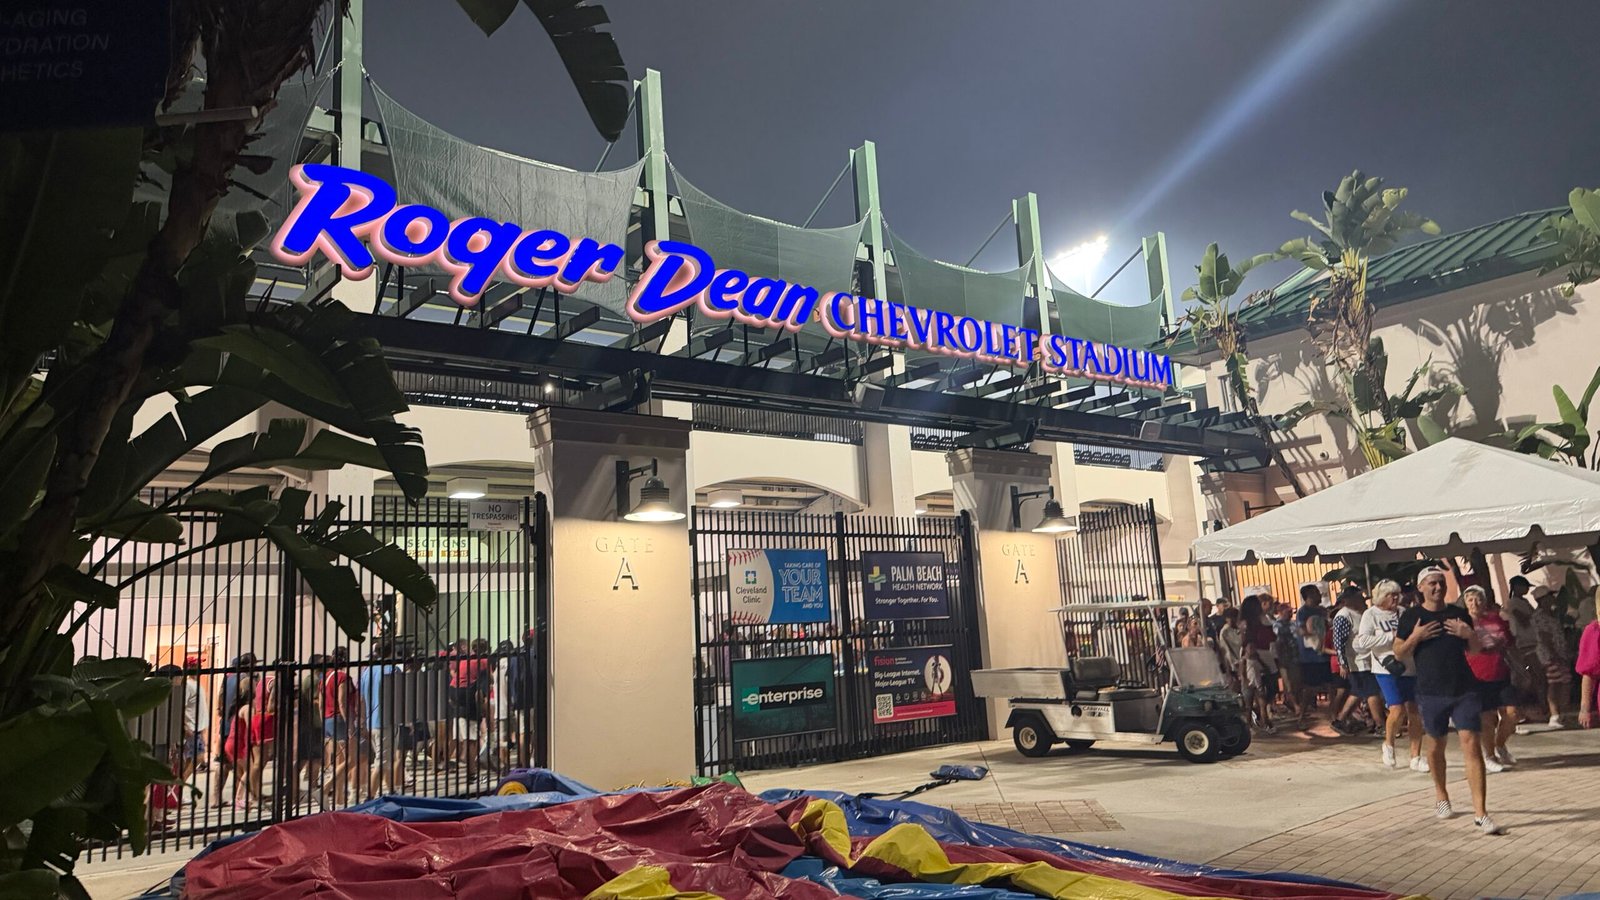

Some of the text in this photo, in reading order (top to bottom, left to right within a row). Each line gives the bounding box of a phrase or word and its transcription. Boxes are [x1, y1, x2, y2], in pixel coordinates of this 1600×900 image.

[280, 163, 1173, 386] Roger Dean CHEVROLET STADIUM
[488, 504, 502, 512] NO
[472, 512, 517, 521] TRESPASSING
[595, 536, 654, 553] GATE
[1001, 543, 1036, 556] GATE
[612, 557, 639, 590] A
[779, 568, 822, 586] YOUR
[891, 565, 943, 581] PALM BEACH
[1014, 559, 1029, 584] A
[736, 586, 767, 595] Cleveland
[782, 585, 823, 603] TEAM
[892, 583, 914, 591] HEALTH
[743, 596, 761, 604] Clinic
[875, 597, 896, 606] Stronger
[874, 655, 895, 666] fision
[742, 686, 823, 705] enterprise
